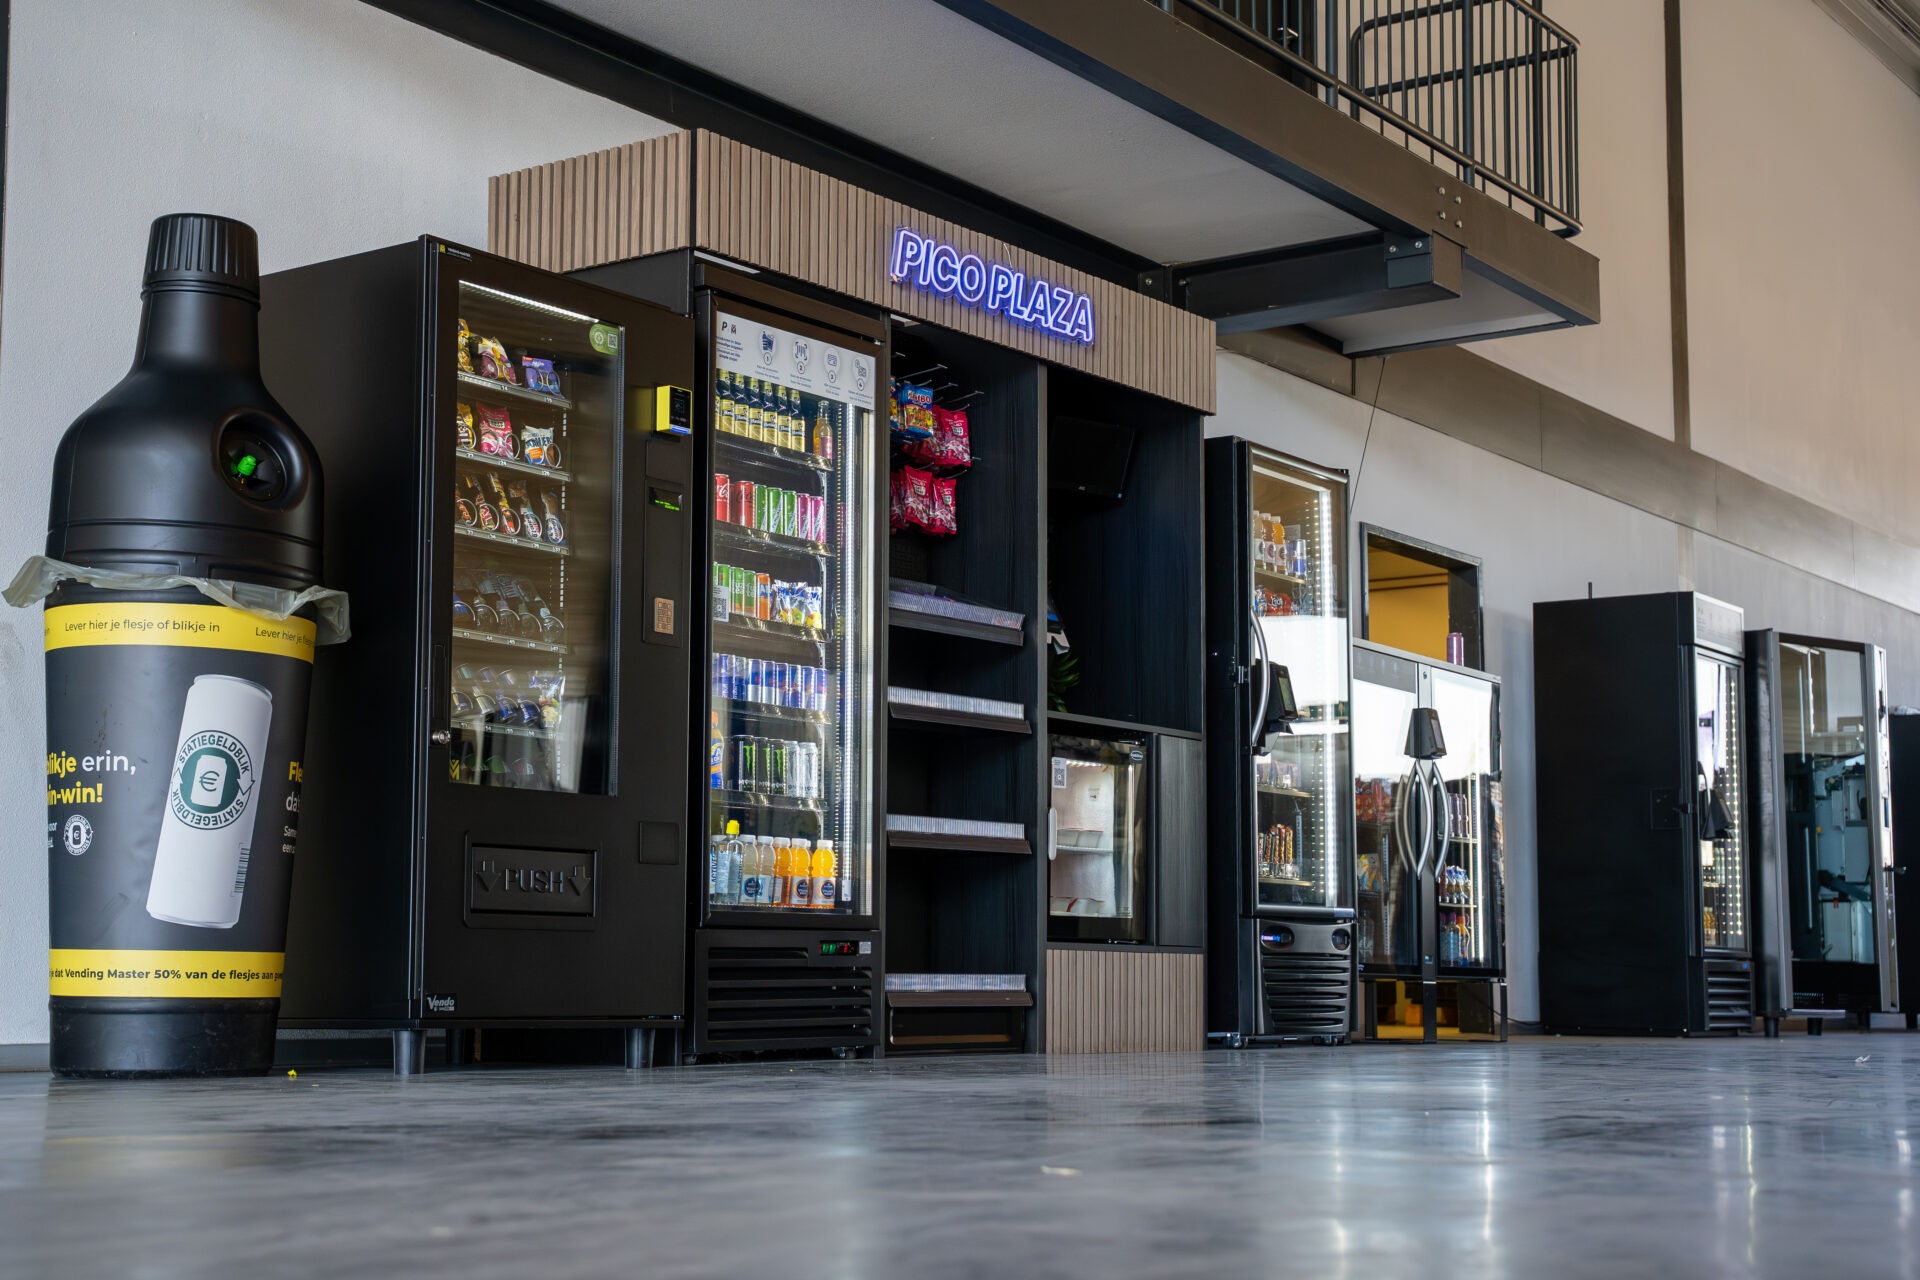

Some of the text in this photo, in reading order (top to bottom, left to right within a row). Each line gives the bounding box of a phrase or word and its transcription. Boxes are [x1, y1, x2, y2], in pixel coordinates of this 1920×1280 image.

[893, 229, 1093, 342] PICO PLAZA
[65, 619, 221, 633] Lever hier je flesje of blikje in
[255, 627, 280, 639] Lever
[282, 630, 296, 641] hier
[82, 749, 136, 775] erin,
[179, 734, 250, 775] STATIEGELDBLIK
[172, 788, 244, 826] STATIEGELDBLIK
[505, 868, 563, 893] PUSH
[65, 968, 104, 980] Vending
[107, 969, 151, 979] Master
[154, 969, 181, 979] 50%
[185, 971, 208, 979] van
[211, 969, 226, 979] de
[229, 969, 260, 981] flesjes
[261, 972, 274, 980] aan
[426, 994, 455, 1010] Vendo
